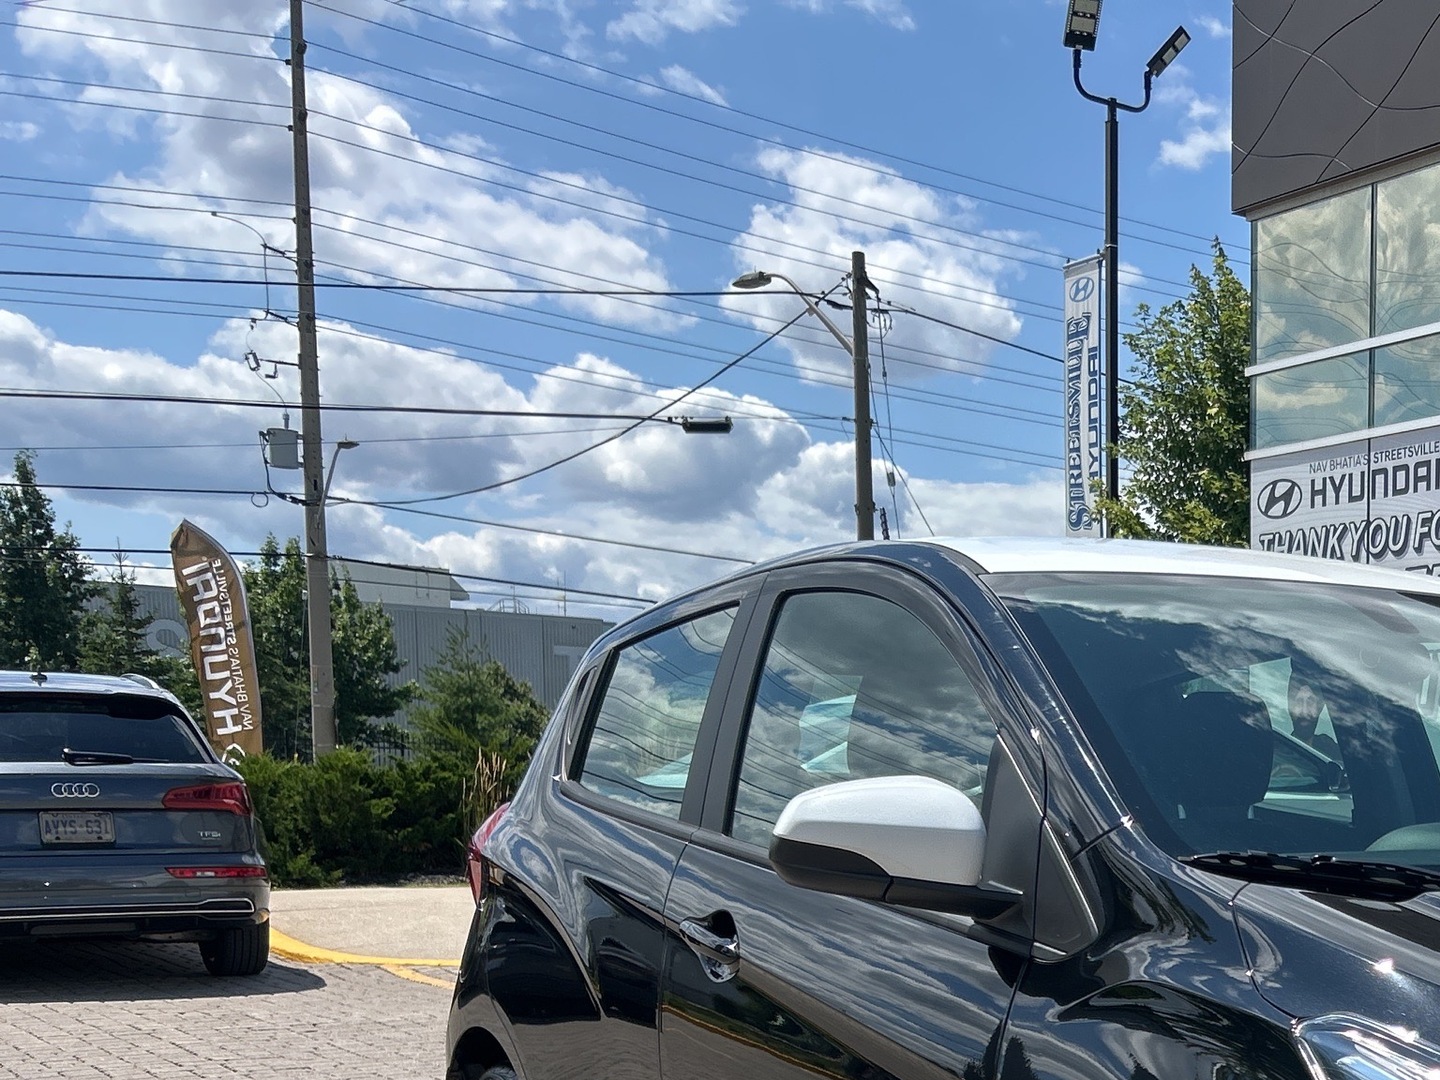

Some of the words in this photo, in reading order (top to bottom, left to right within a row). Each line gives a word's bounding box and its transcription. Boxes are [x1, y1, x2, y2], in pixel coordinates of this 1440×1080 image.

[1066, 311, 1092, 531] STREETSVILLE
[1309, 463, 1328, 475] NAV
[1329, 454, 1369, 472] BHATIA'S
[1373, 441, 1440, 464] STREETSVILLE
[1310, 458, 1440, 509] HYUNDAI
[1259, 522, 1351, 561] THANK
[1349, 514, 1411, 561] YOU
